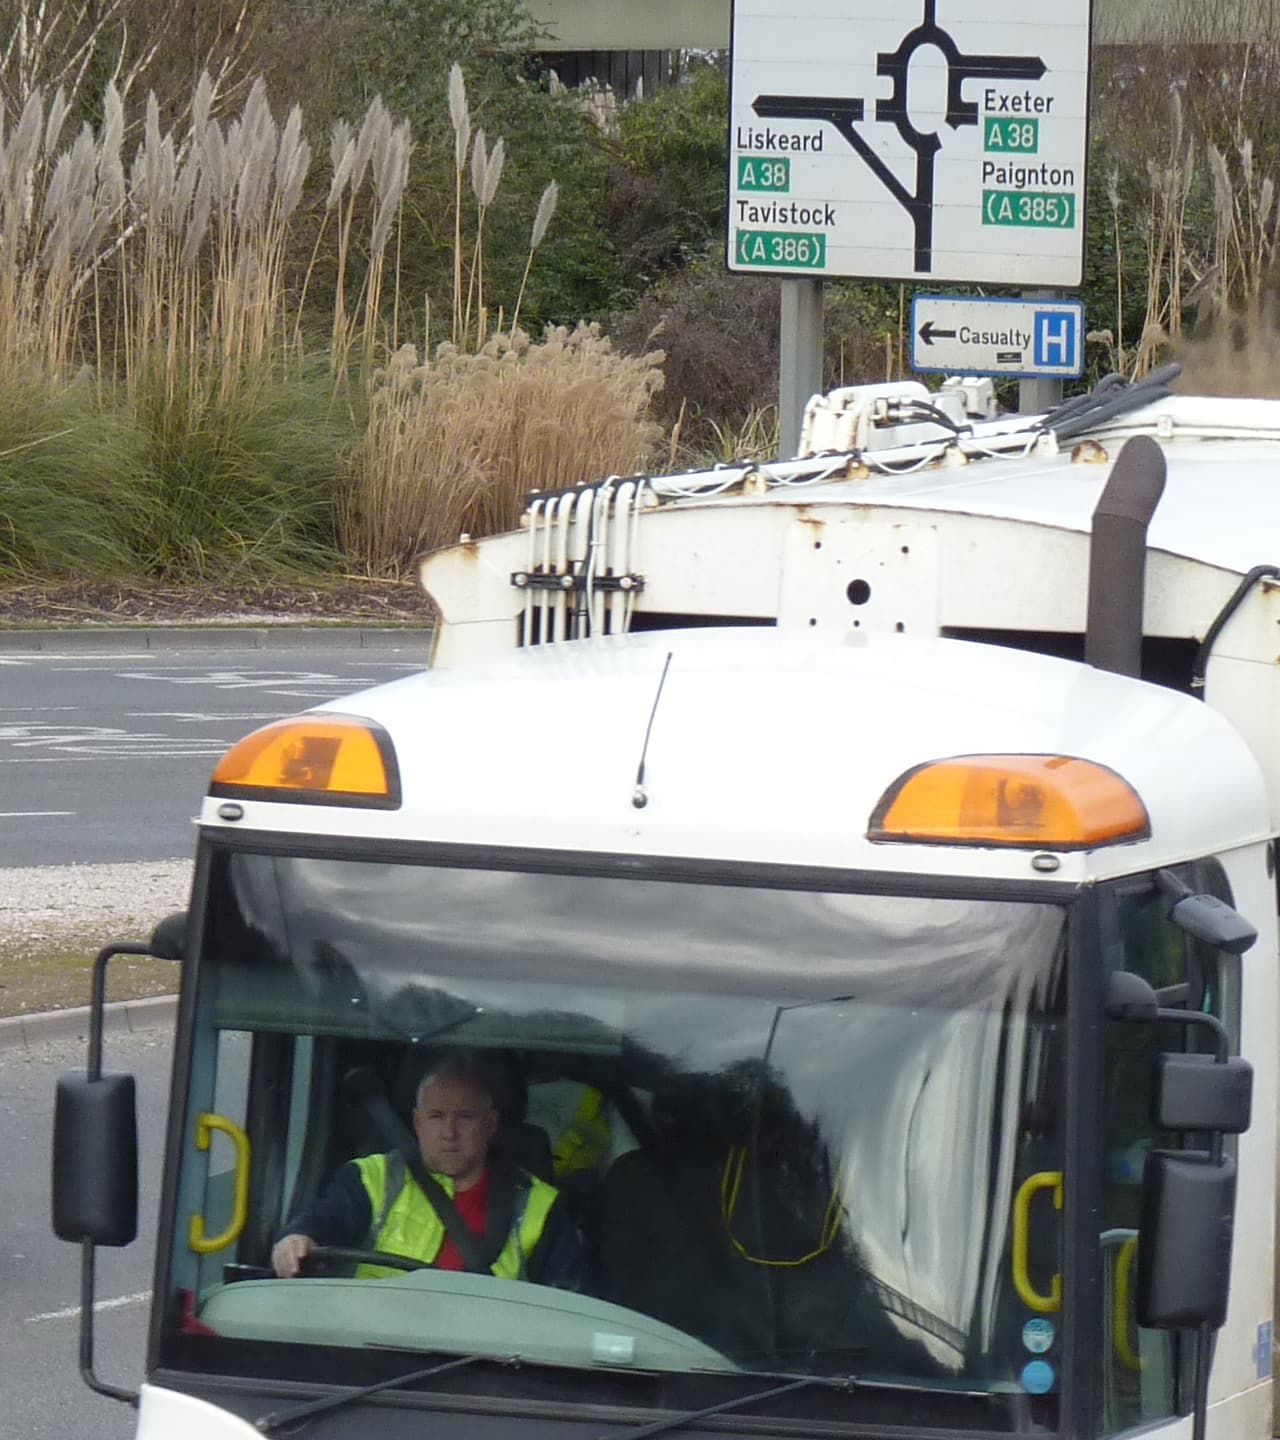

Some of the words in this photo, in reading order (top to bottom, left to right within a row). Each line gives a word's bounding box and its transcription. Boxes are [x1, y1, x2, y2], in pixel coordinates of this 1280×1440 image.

[984, 88, 1054, 114] Exeter
[737, 126, 823, 152] Liskeard
[982, 161, 1074, 189] Paignton
[736, 200, 836, 226] Tavistock
[959, 326, 1031, 350] Casualty
[1042, 318, 1067, 363] H
